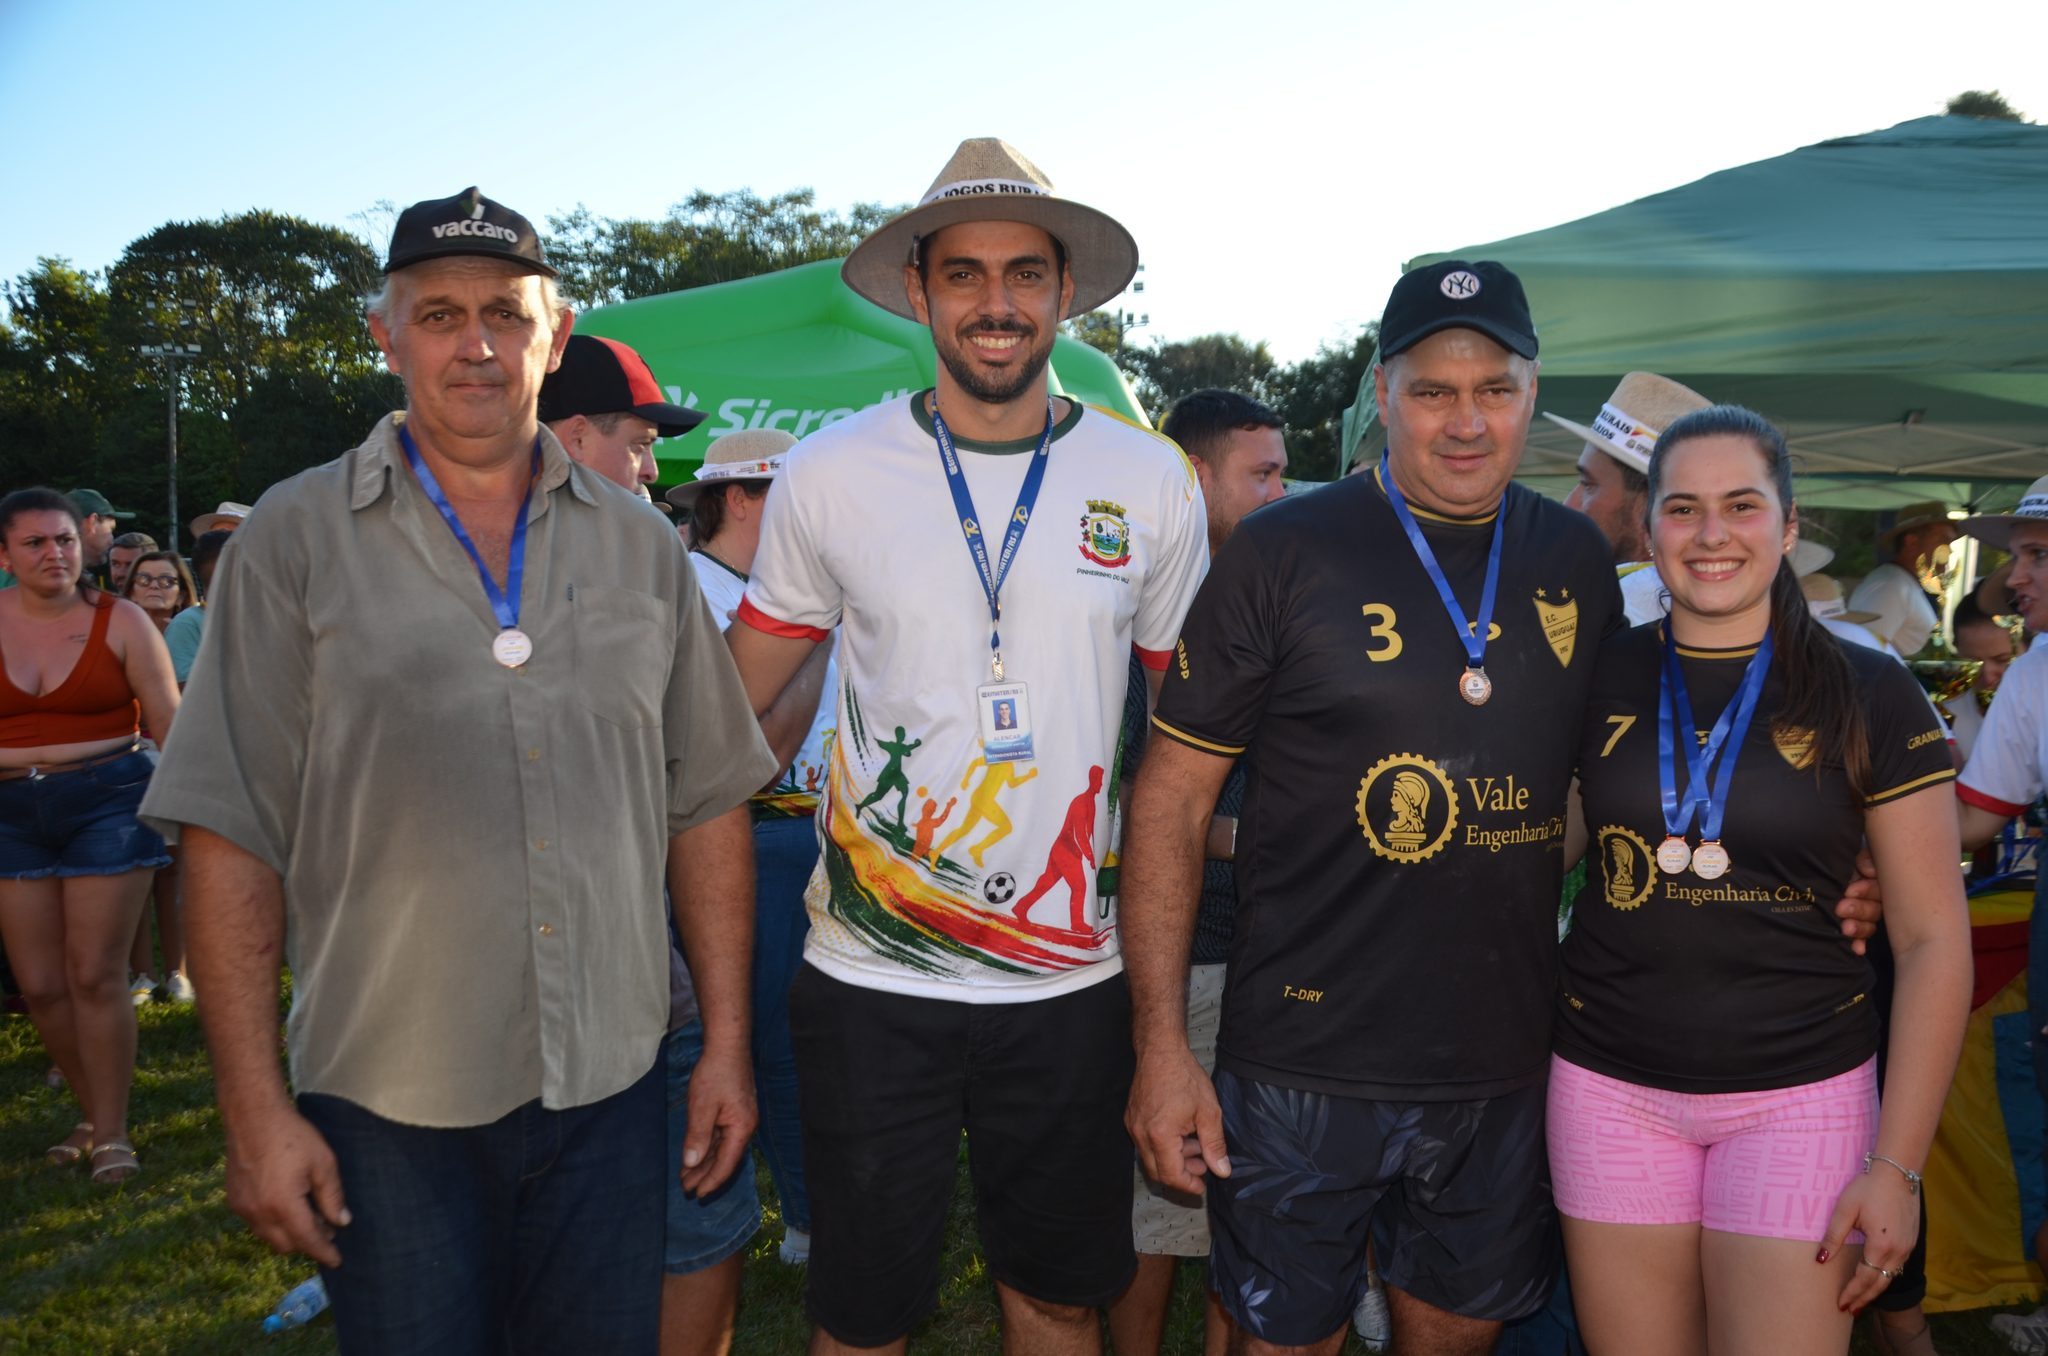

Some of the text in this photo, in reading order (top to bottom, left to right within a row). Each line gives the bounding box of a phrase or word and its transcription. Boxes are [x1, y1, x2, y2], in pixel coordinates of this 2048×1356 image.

[432, 220, 518, 243] vaccaro
[707, 388, 909, 437] Sicre
[1362, 603, 1403, 662] 3
[1600, 715, 1637, 757] 7
[1466, 774, 1529, 811] Vale
[1464, 821, 1548, 853] Engenharia
[1664, 882, 1770, 906] Engenharia
[1284, 985, 1324, 1003] T-DRY
